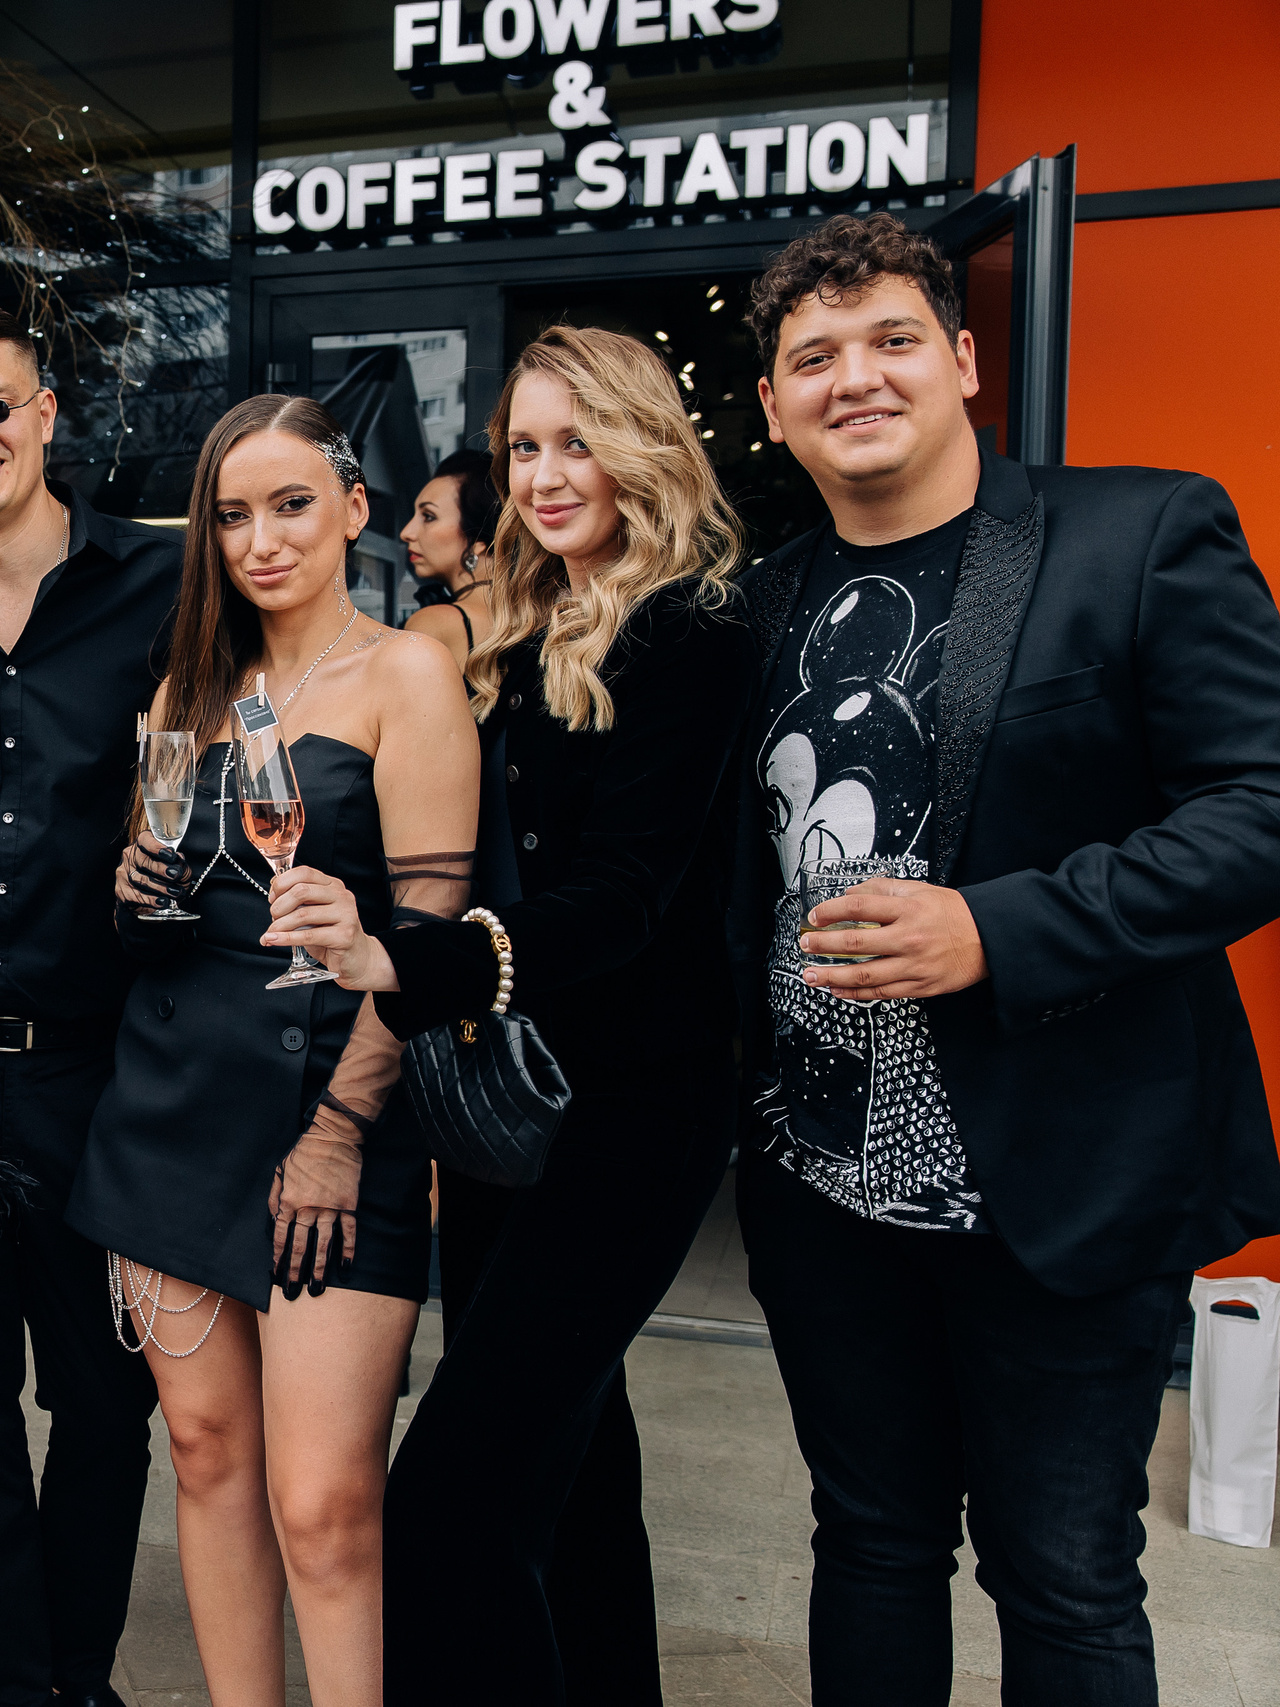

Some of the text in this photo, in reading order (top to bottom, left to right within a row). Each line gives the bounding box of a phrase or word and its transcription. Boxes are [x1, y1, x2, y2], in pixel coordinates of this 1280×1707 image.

[549, 60, 611, 130] &
[252, 113, 930, 235] COFFEE STATION
